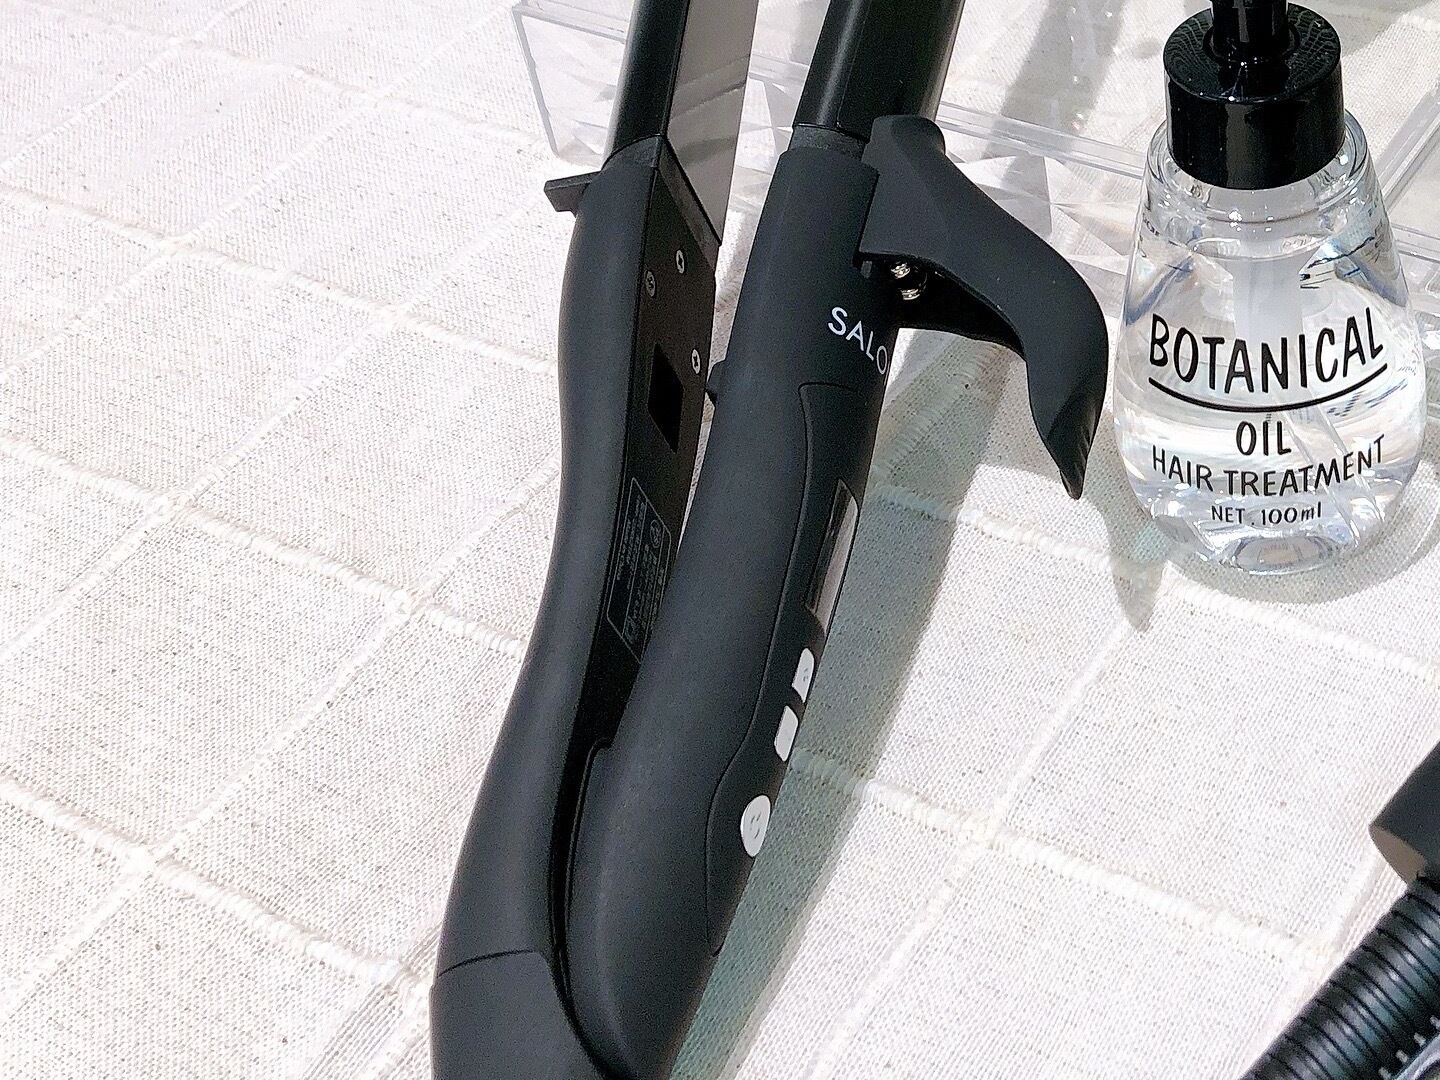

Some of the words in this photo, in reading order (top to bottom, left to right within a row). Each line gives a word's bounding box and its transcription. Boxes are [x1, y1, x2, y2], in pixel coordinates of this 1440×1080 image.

[827, 306, 888, 375] SALO
[1150, 307, 1384, 394] BOTANICAL
[1153, 444, 1213, 492] HAIR
[1223, 434, 1385, 497] TREATMENT
[1235, 421, 1291, 456] OIL
[1261, 501, 1322, 525] 100ml
